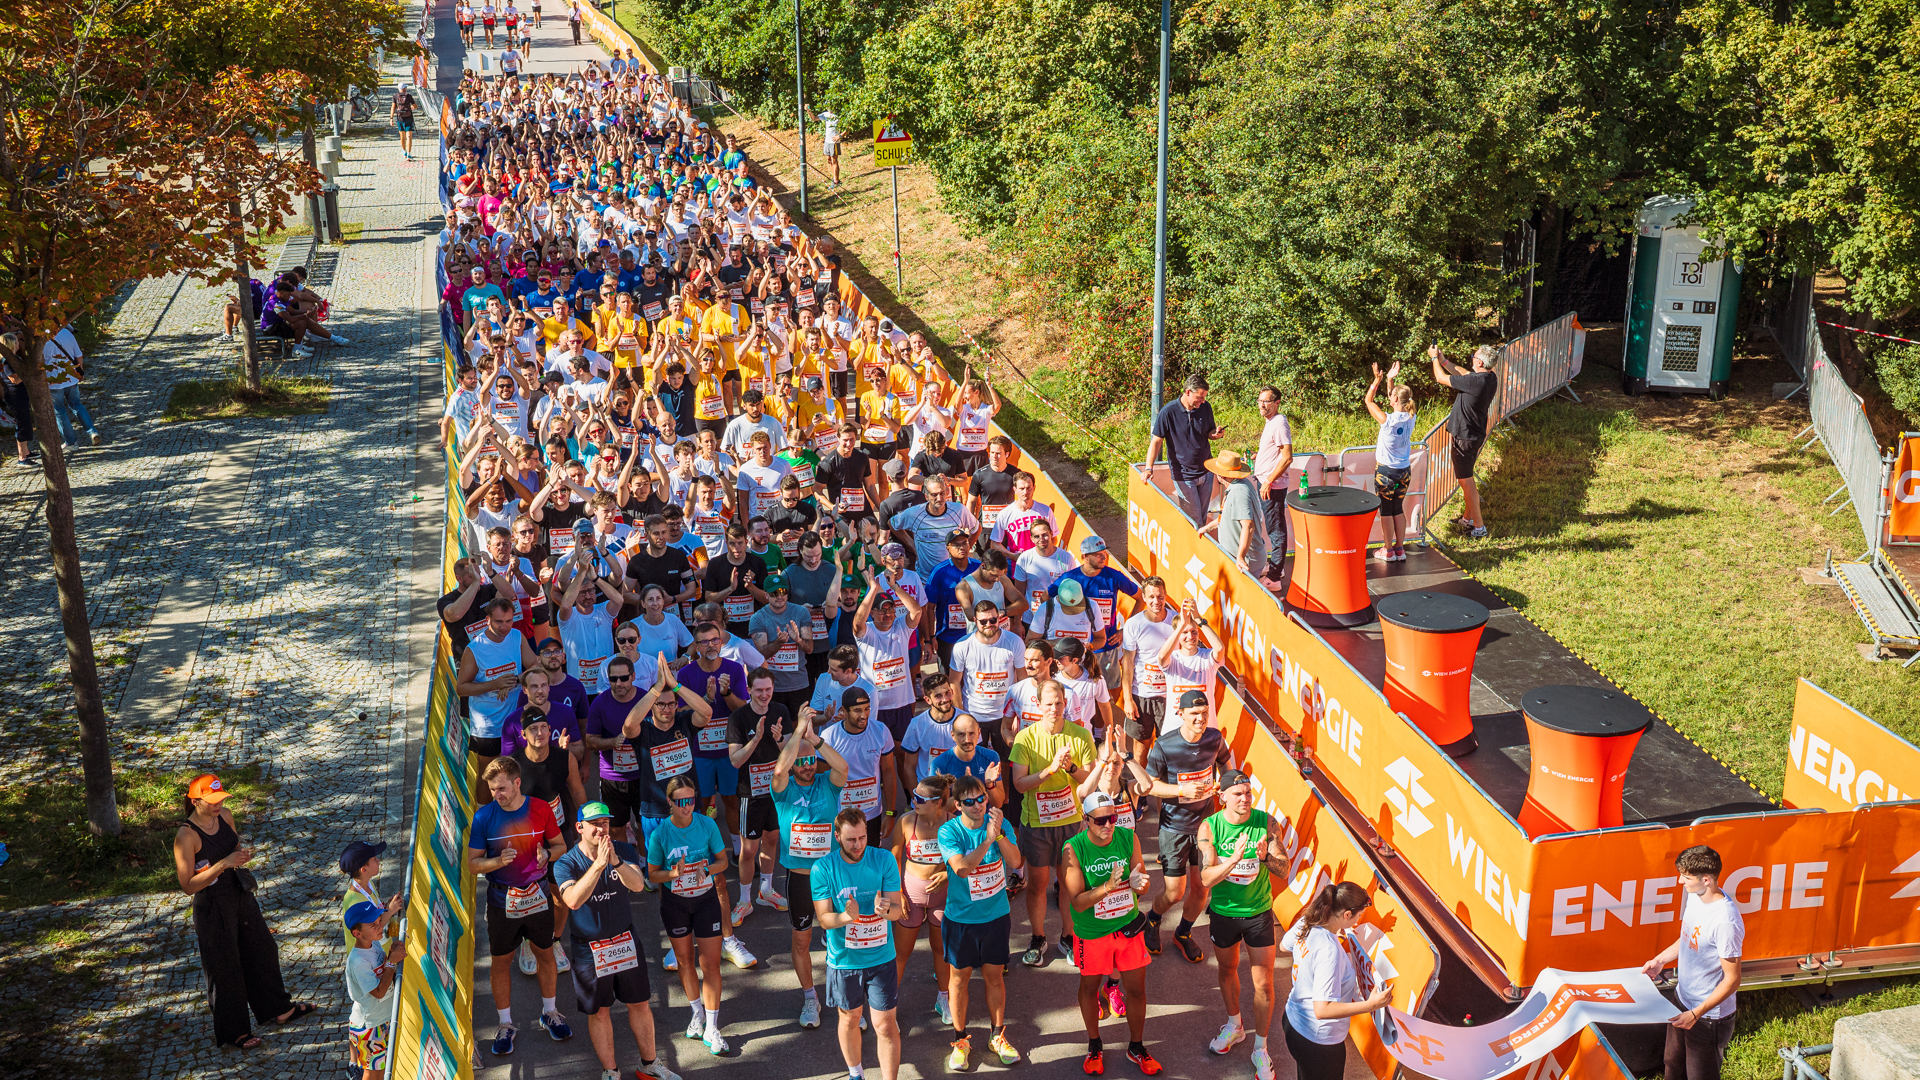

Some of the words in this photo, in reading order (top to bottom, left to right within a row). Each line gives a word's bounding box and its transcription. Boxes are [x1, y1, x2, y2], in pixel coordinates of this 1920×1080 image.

[1682, 262, 1704, 273] TOI
[1681, 273, 1702, 284] TOI
[1129, 500, 1171, 570] ERGIE
[1449, 667, 1467, 676] ENERGIE
[1220, 590, 1267, 673] WIEN
[1271, 643, 1363, 767] ENERGIE
[665, 751, 688, 763] 2659C
[1551, 769, 1566, 779] WIEN
[1567, 775, 1594, 783] ENERGIE
[855, 788, 872, 797] 441C
[806, 836, 826, 844] 256B
[924, 842, 938, 850] 672
[1234, 862, 1256, 870] 365A
[1446, 812, 1530, 945] WIEN
[520, 894, 543, 907] 8624A
[1108, 893, 1130, 906] 8366B
[1551, 861, 1829, 937] ENEGIE
[863, 924, 882, 934] 244C
[608, 946, 632, 958] 2656A
[1556, 988, 1592, 1011] WIEN
[1498, 1011, 1556, 1051] ENERGIE
